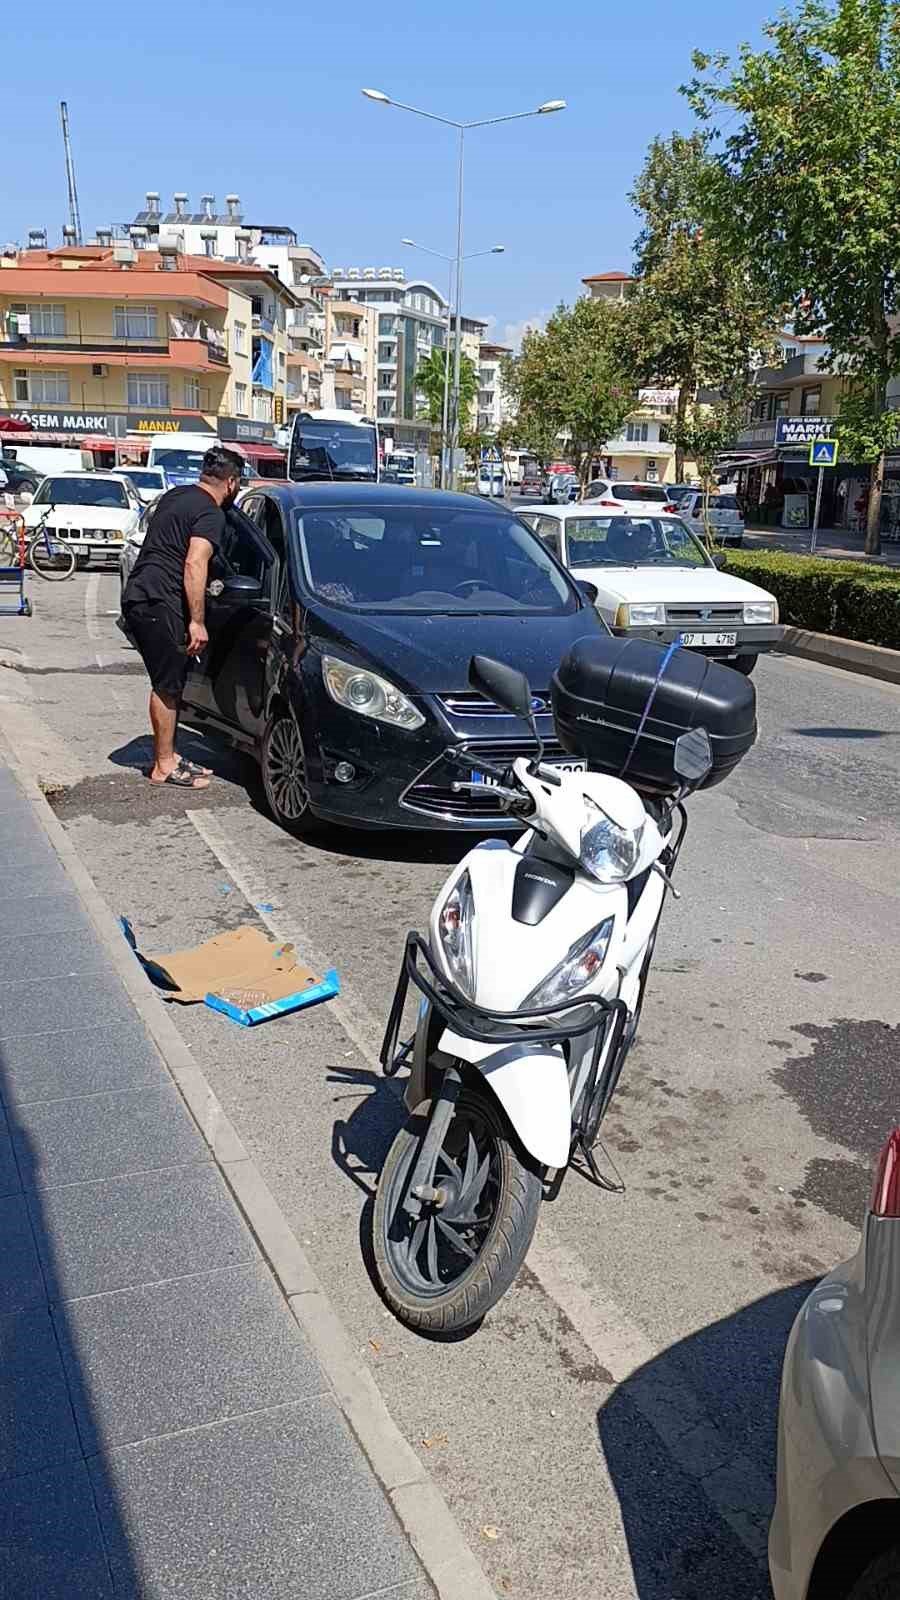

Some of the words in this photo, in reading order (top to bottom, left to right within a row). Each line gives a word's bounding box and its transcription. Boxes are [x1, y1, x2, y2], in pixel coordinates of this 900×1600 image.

[138, 420, 180, 432] MANAV
[785, 433, 828, 441] MANA
[684, 634, 695, 645] 07
[524, 873, 557, 887] HONDA
